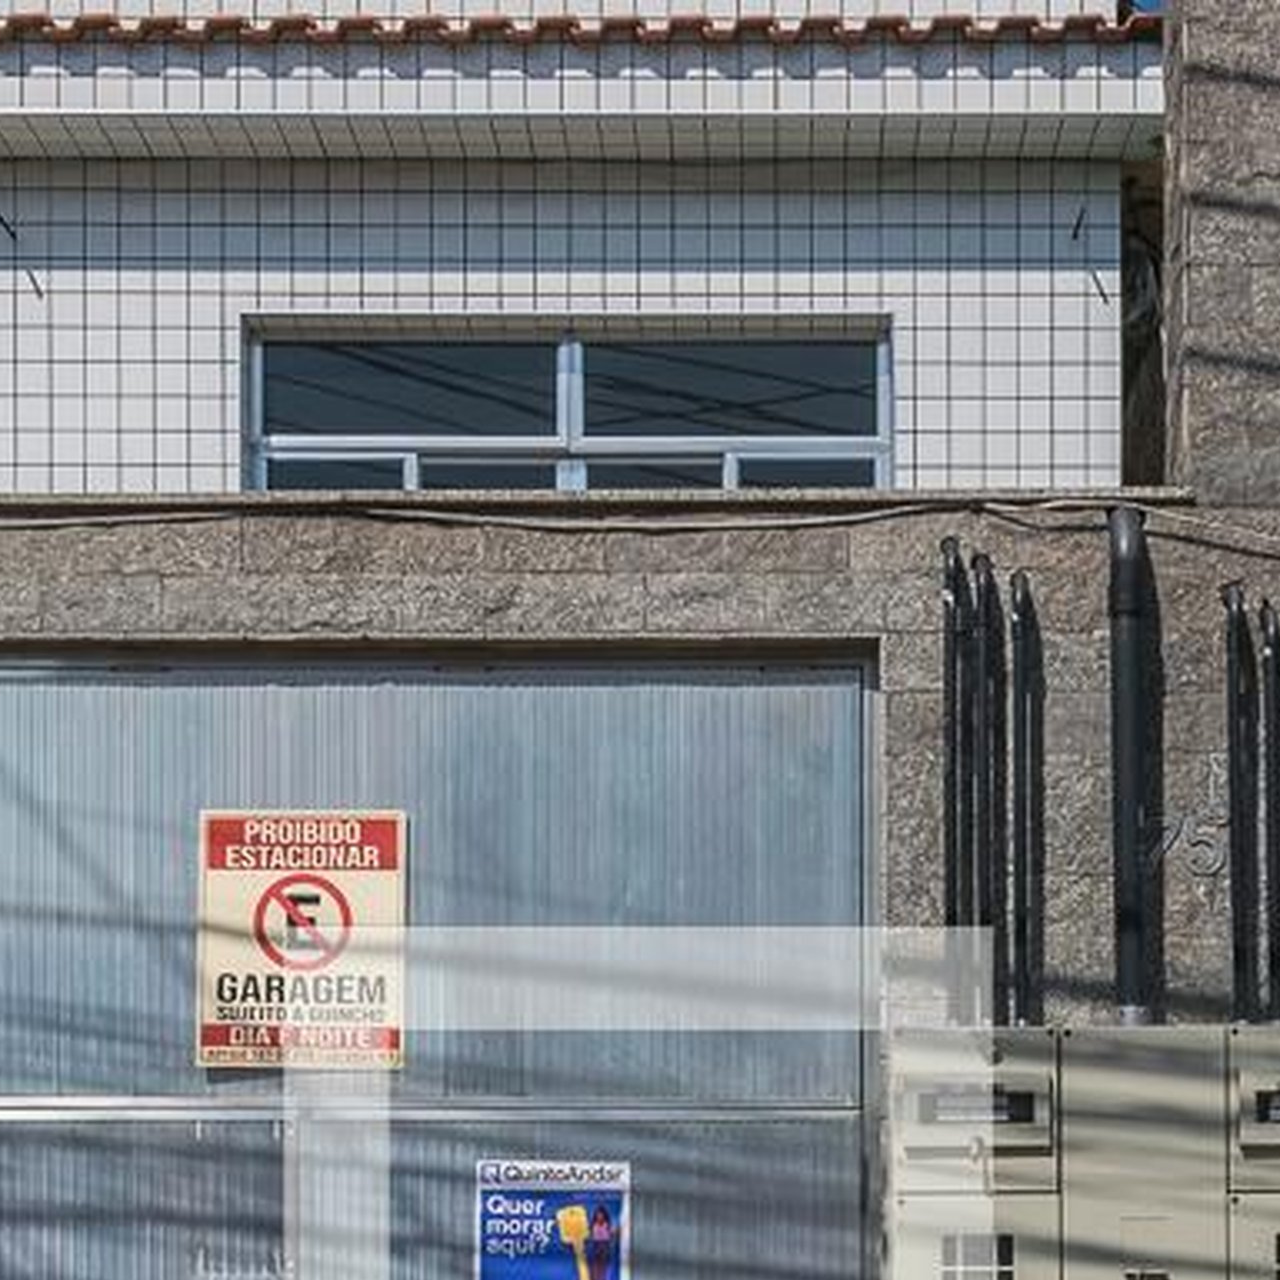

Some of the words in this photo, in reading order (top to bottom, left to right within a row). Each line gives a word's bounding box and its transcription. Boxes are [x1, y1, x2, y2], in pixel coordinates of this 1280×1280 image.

[244, 820, 361, 844] PROIBIDO
[225, 846, 379, 868] ESTACIONAR
[215, 973, 386, 1004] GARAGEM
[215, 1006, 288, 1022] SUJEITO
[228, 1027, 272, 1046] DIA
[307, 1027, 372, 1048] NOITE
[503, 1164, 624, 1183] QuintoAndar
[486, 1194, 545, 1216] Quer
[486, 1218, 556, 1236] morar
[486, 1232, 551, 1259] aqui?
